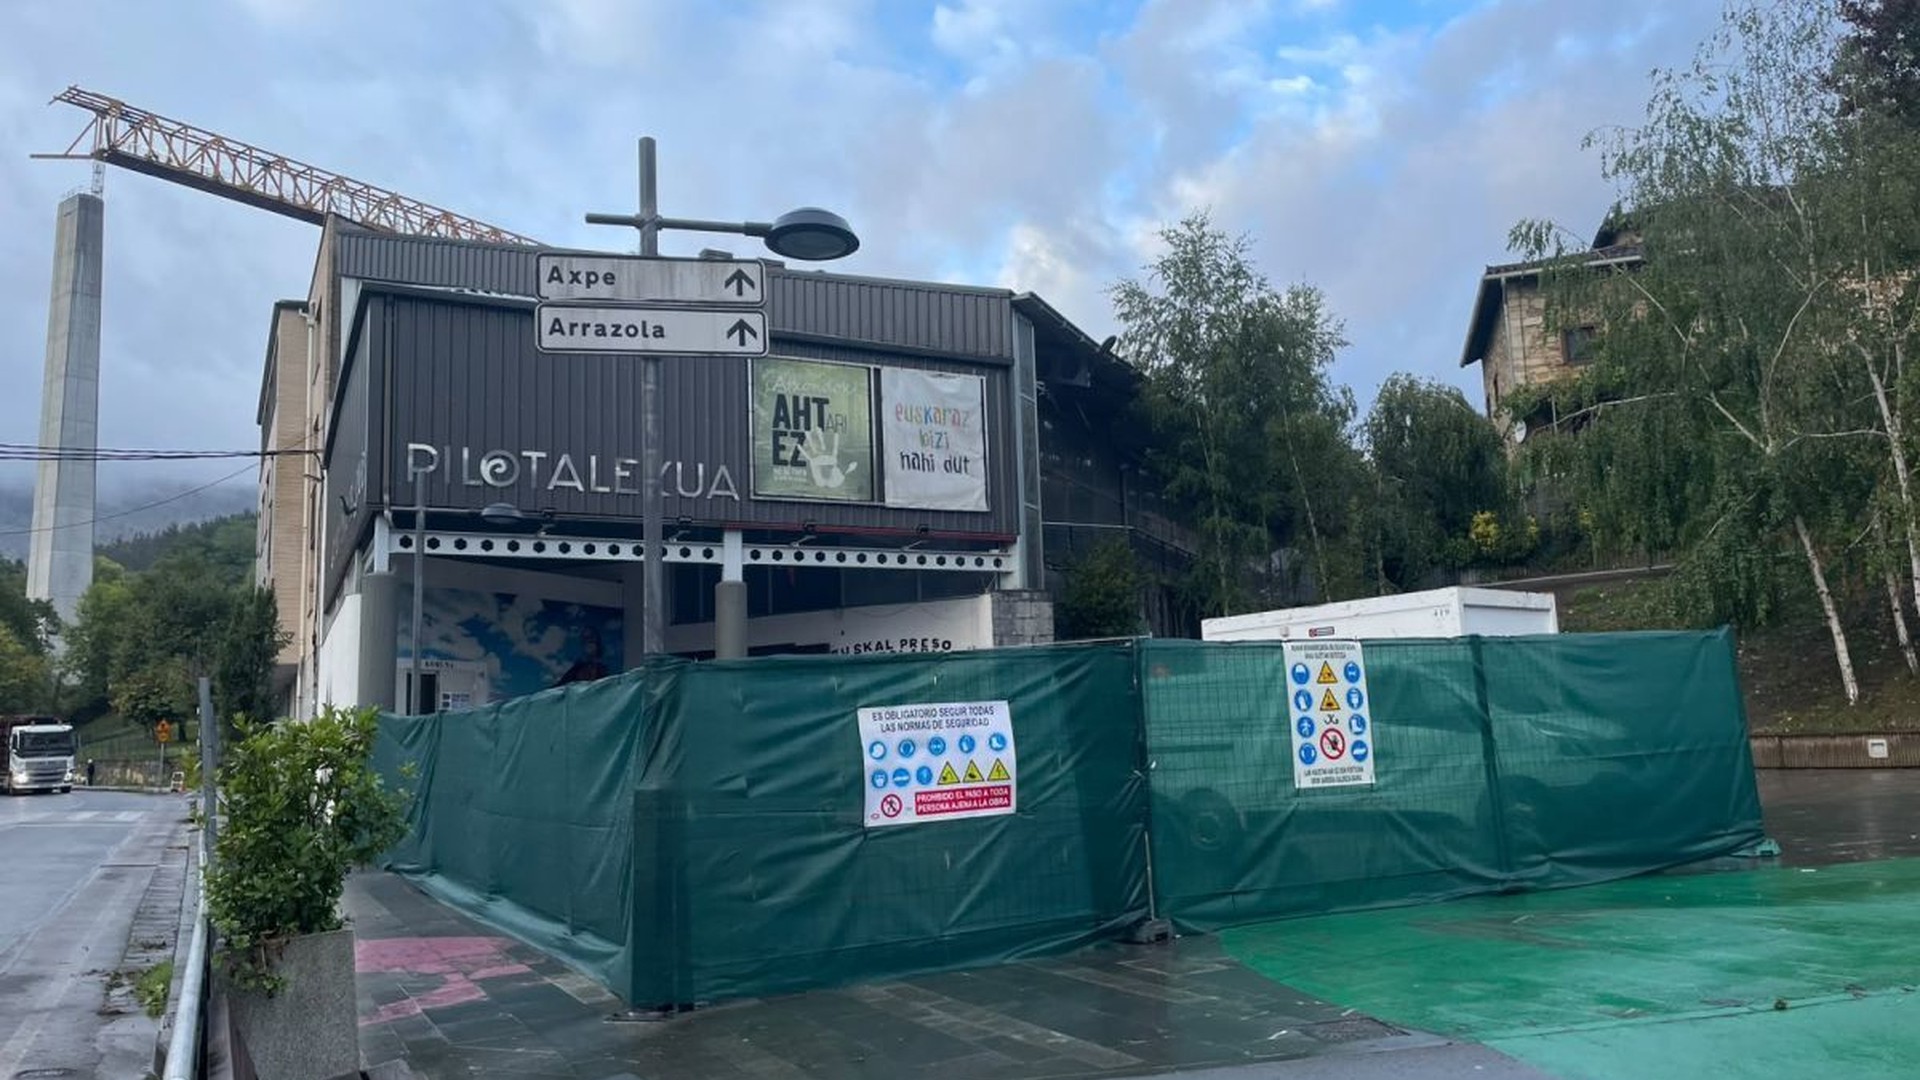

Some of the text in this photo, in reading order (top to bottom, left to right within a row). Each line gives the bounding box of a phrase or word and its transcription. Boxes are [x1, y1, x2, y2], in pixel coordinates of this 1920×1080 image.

[547, 266, 616, 289] Axpe
[548, 317, 666, 339] Arrazola
[895, 403, 970, 428] euskaraz
[772, 430, 807, 467] EZ
[919, 428, 949, 450] bizi
[900, 451, 970, 475] nahi dut
[899, 637, 952, 651] PRESO
[872, 705, 994, 721] ES OBLIGATORIO SEGUIR TODAS
[880, 717, 990, 733] LAS NORMAS DE SEGURIDAD
[916, 791, 955, 803] PROHIBIDO
[955, 790, 965, 799] EL
[965, 788, 982, 798] PASO
[989, 787, 1009, 797] TODA
[917, 802, 951, 813] PERSONA
[978, 798, 987, 807] LA
[988, 796, 1009, 806] OBRA
